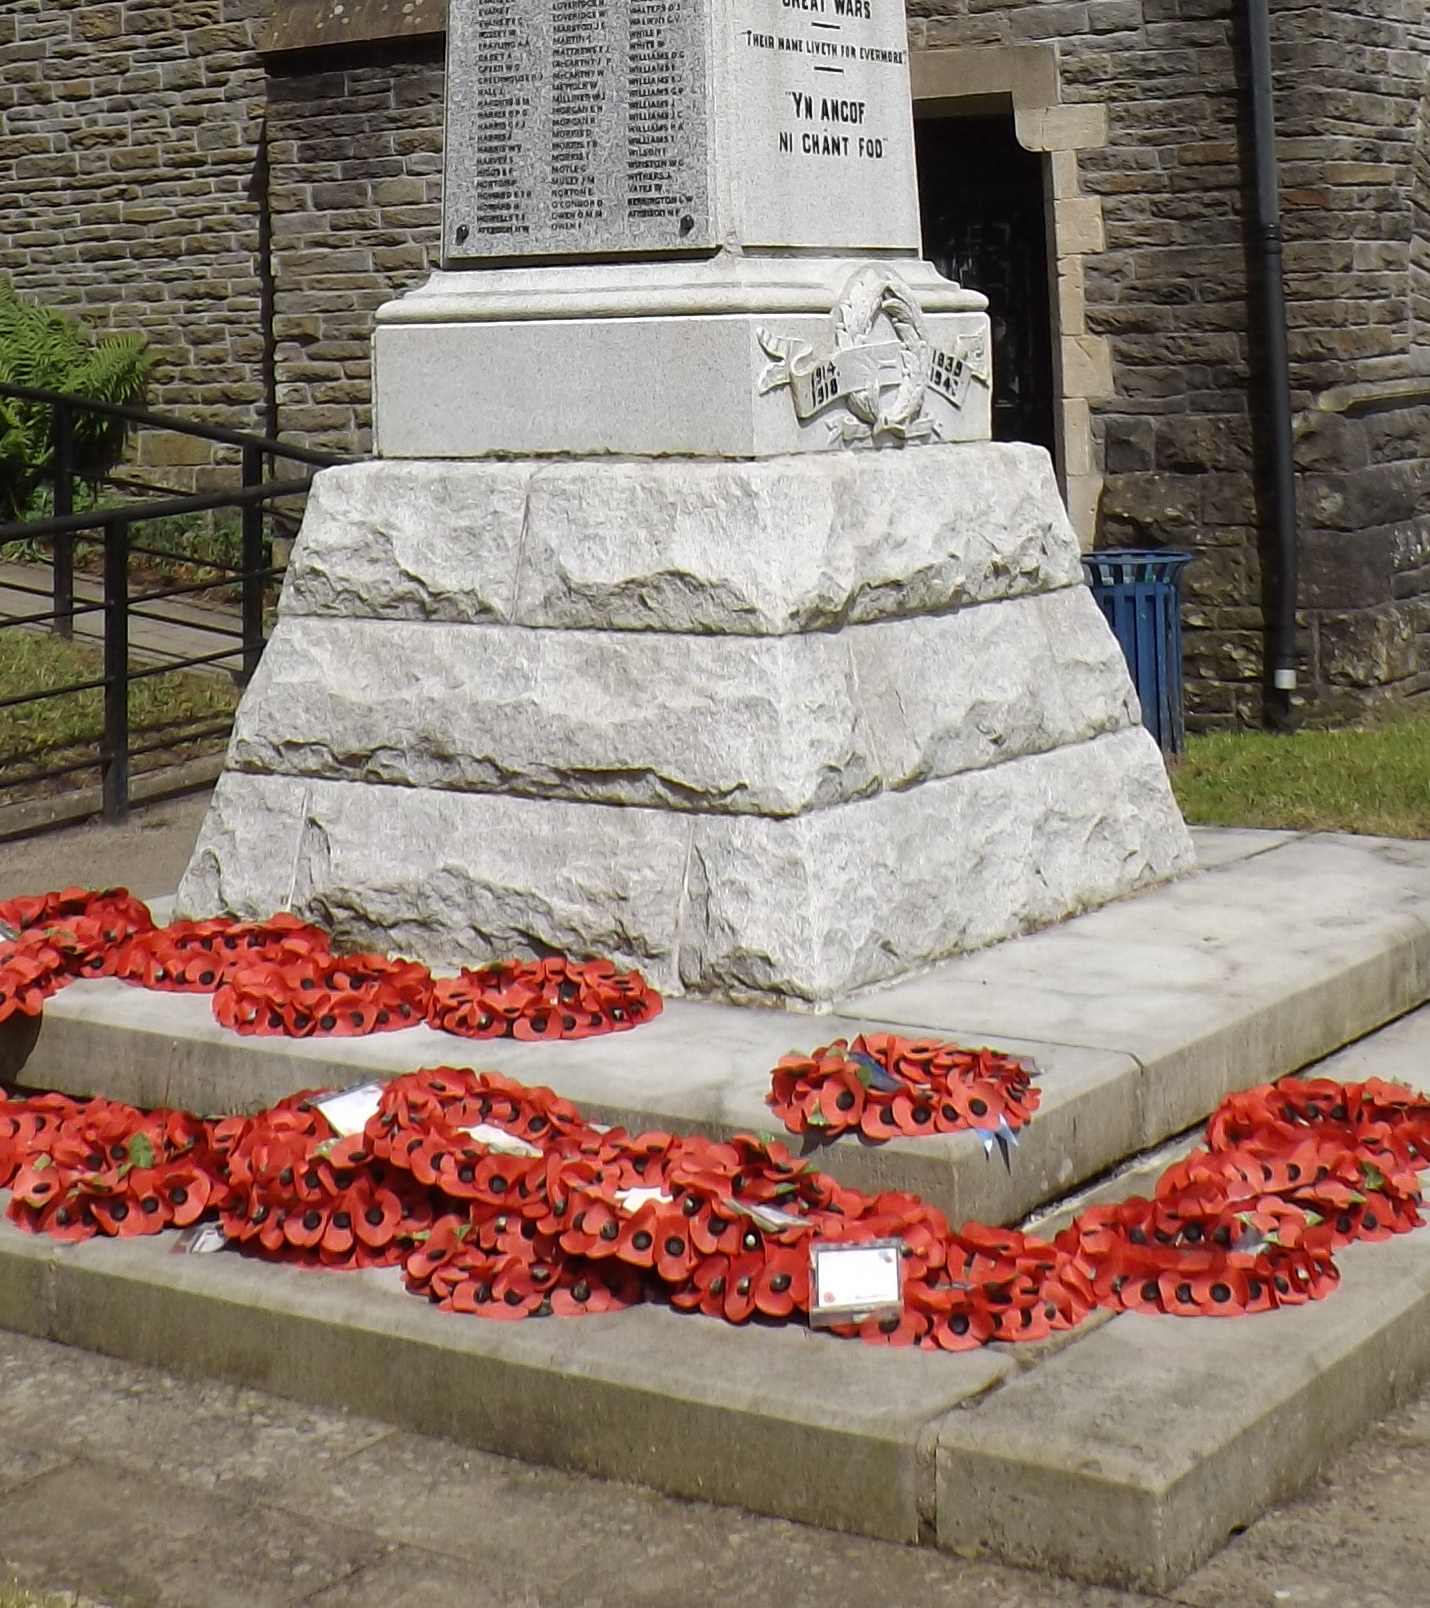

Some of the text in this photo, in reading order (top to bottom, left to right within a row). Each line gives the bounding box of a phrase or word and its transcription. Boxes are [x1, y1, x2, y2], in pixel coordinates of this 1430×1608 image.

[778, 39, 802, 52] NAME
[806, 41, 837, 56] LIVETH
[841, 45, 856, 58] FOR
[821, 98, 865, 124] ANGOF
[779, 132, 793, 152] NI
